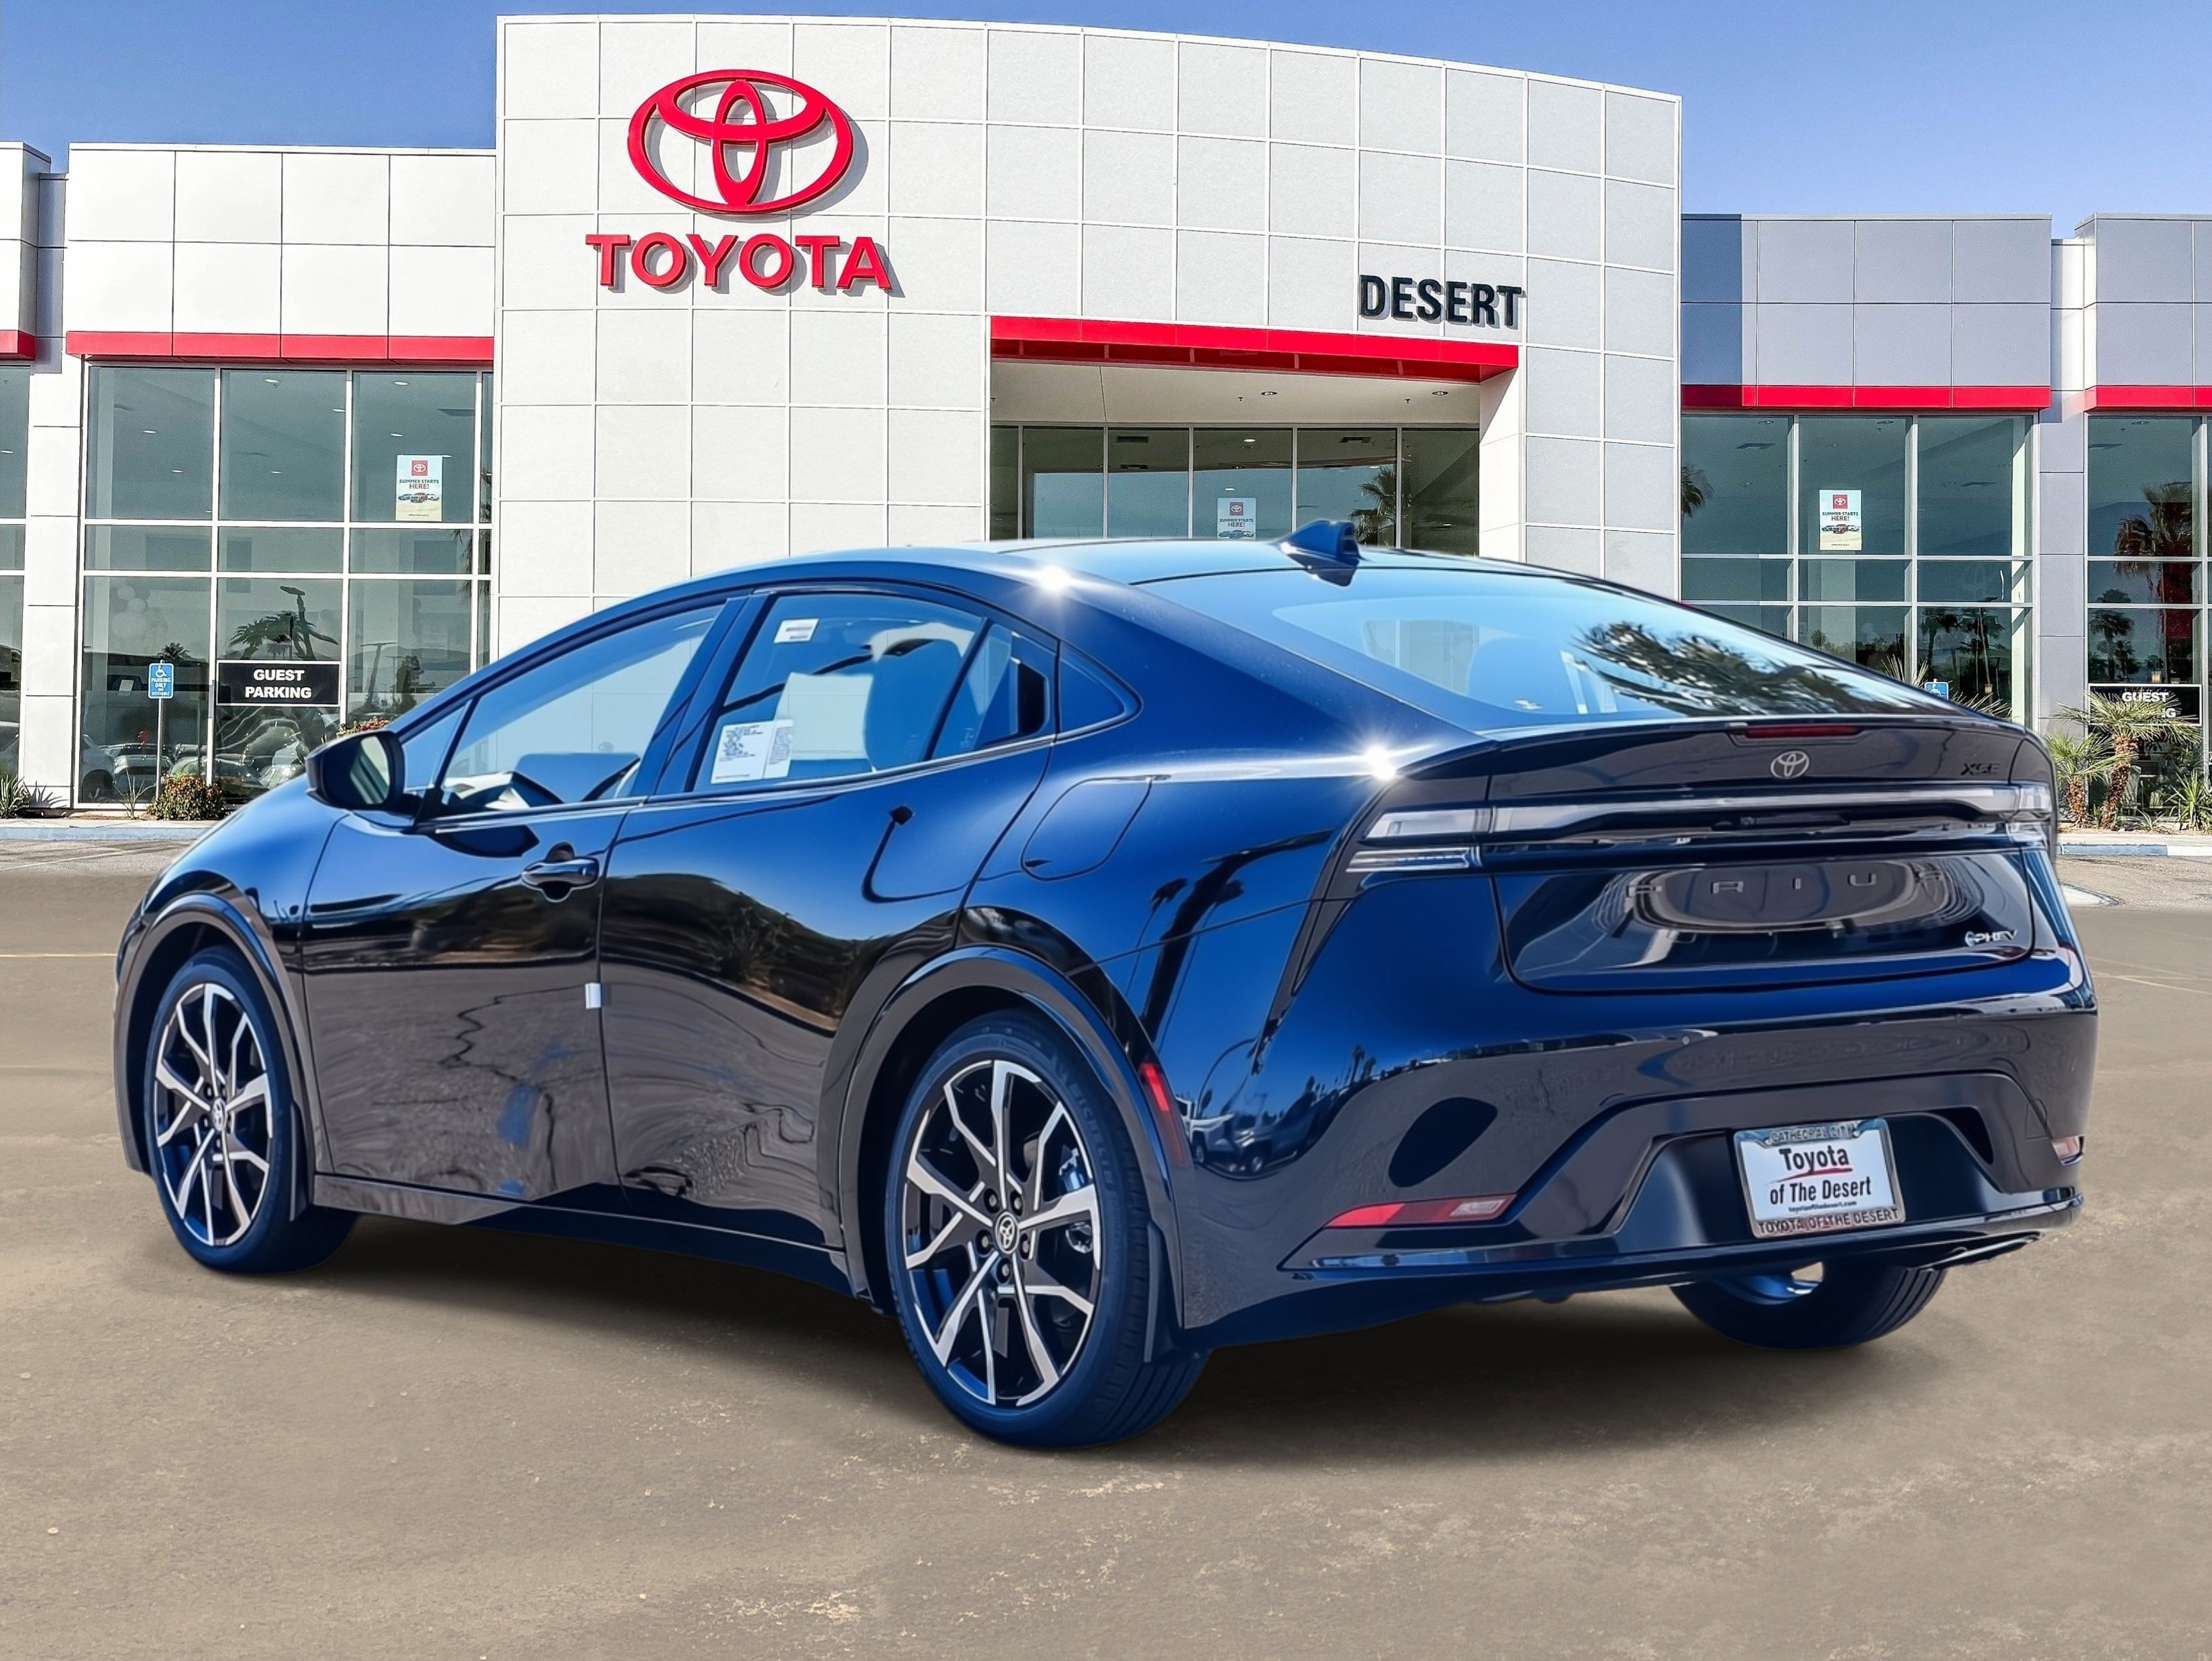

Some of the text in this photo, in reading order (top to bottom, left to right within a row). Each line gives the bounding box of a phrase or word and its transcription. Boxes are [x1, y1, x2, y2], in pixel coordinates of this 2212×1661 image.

[586, 232, 893, 291] TOYOTA
[1359, 274, 1522, 328] DESERT
[253, 669, 305, 681] GUEST
[245, 686, 312, 699] PARKING
[2121, 691, 2170, 703] GUEST
[1778, 1145, 1850, 1174] Toyota
[1770, 1176, 1871, 1205] of The Desert
[1758, 1208, 1899, 1234] TOYOTA OF THE DESERT
